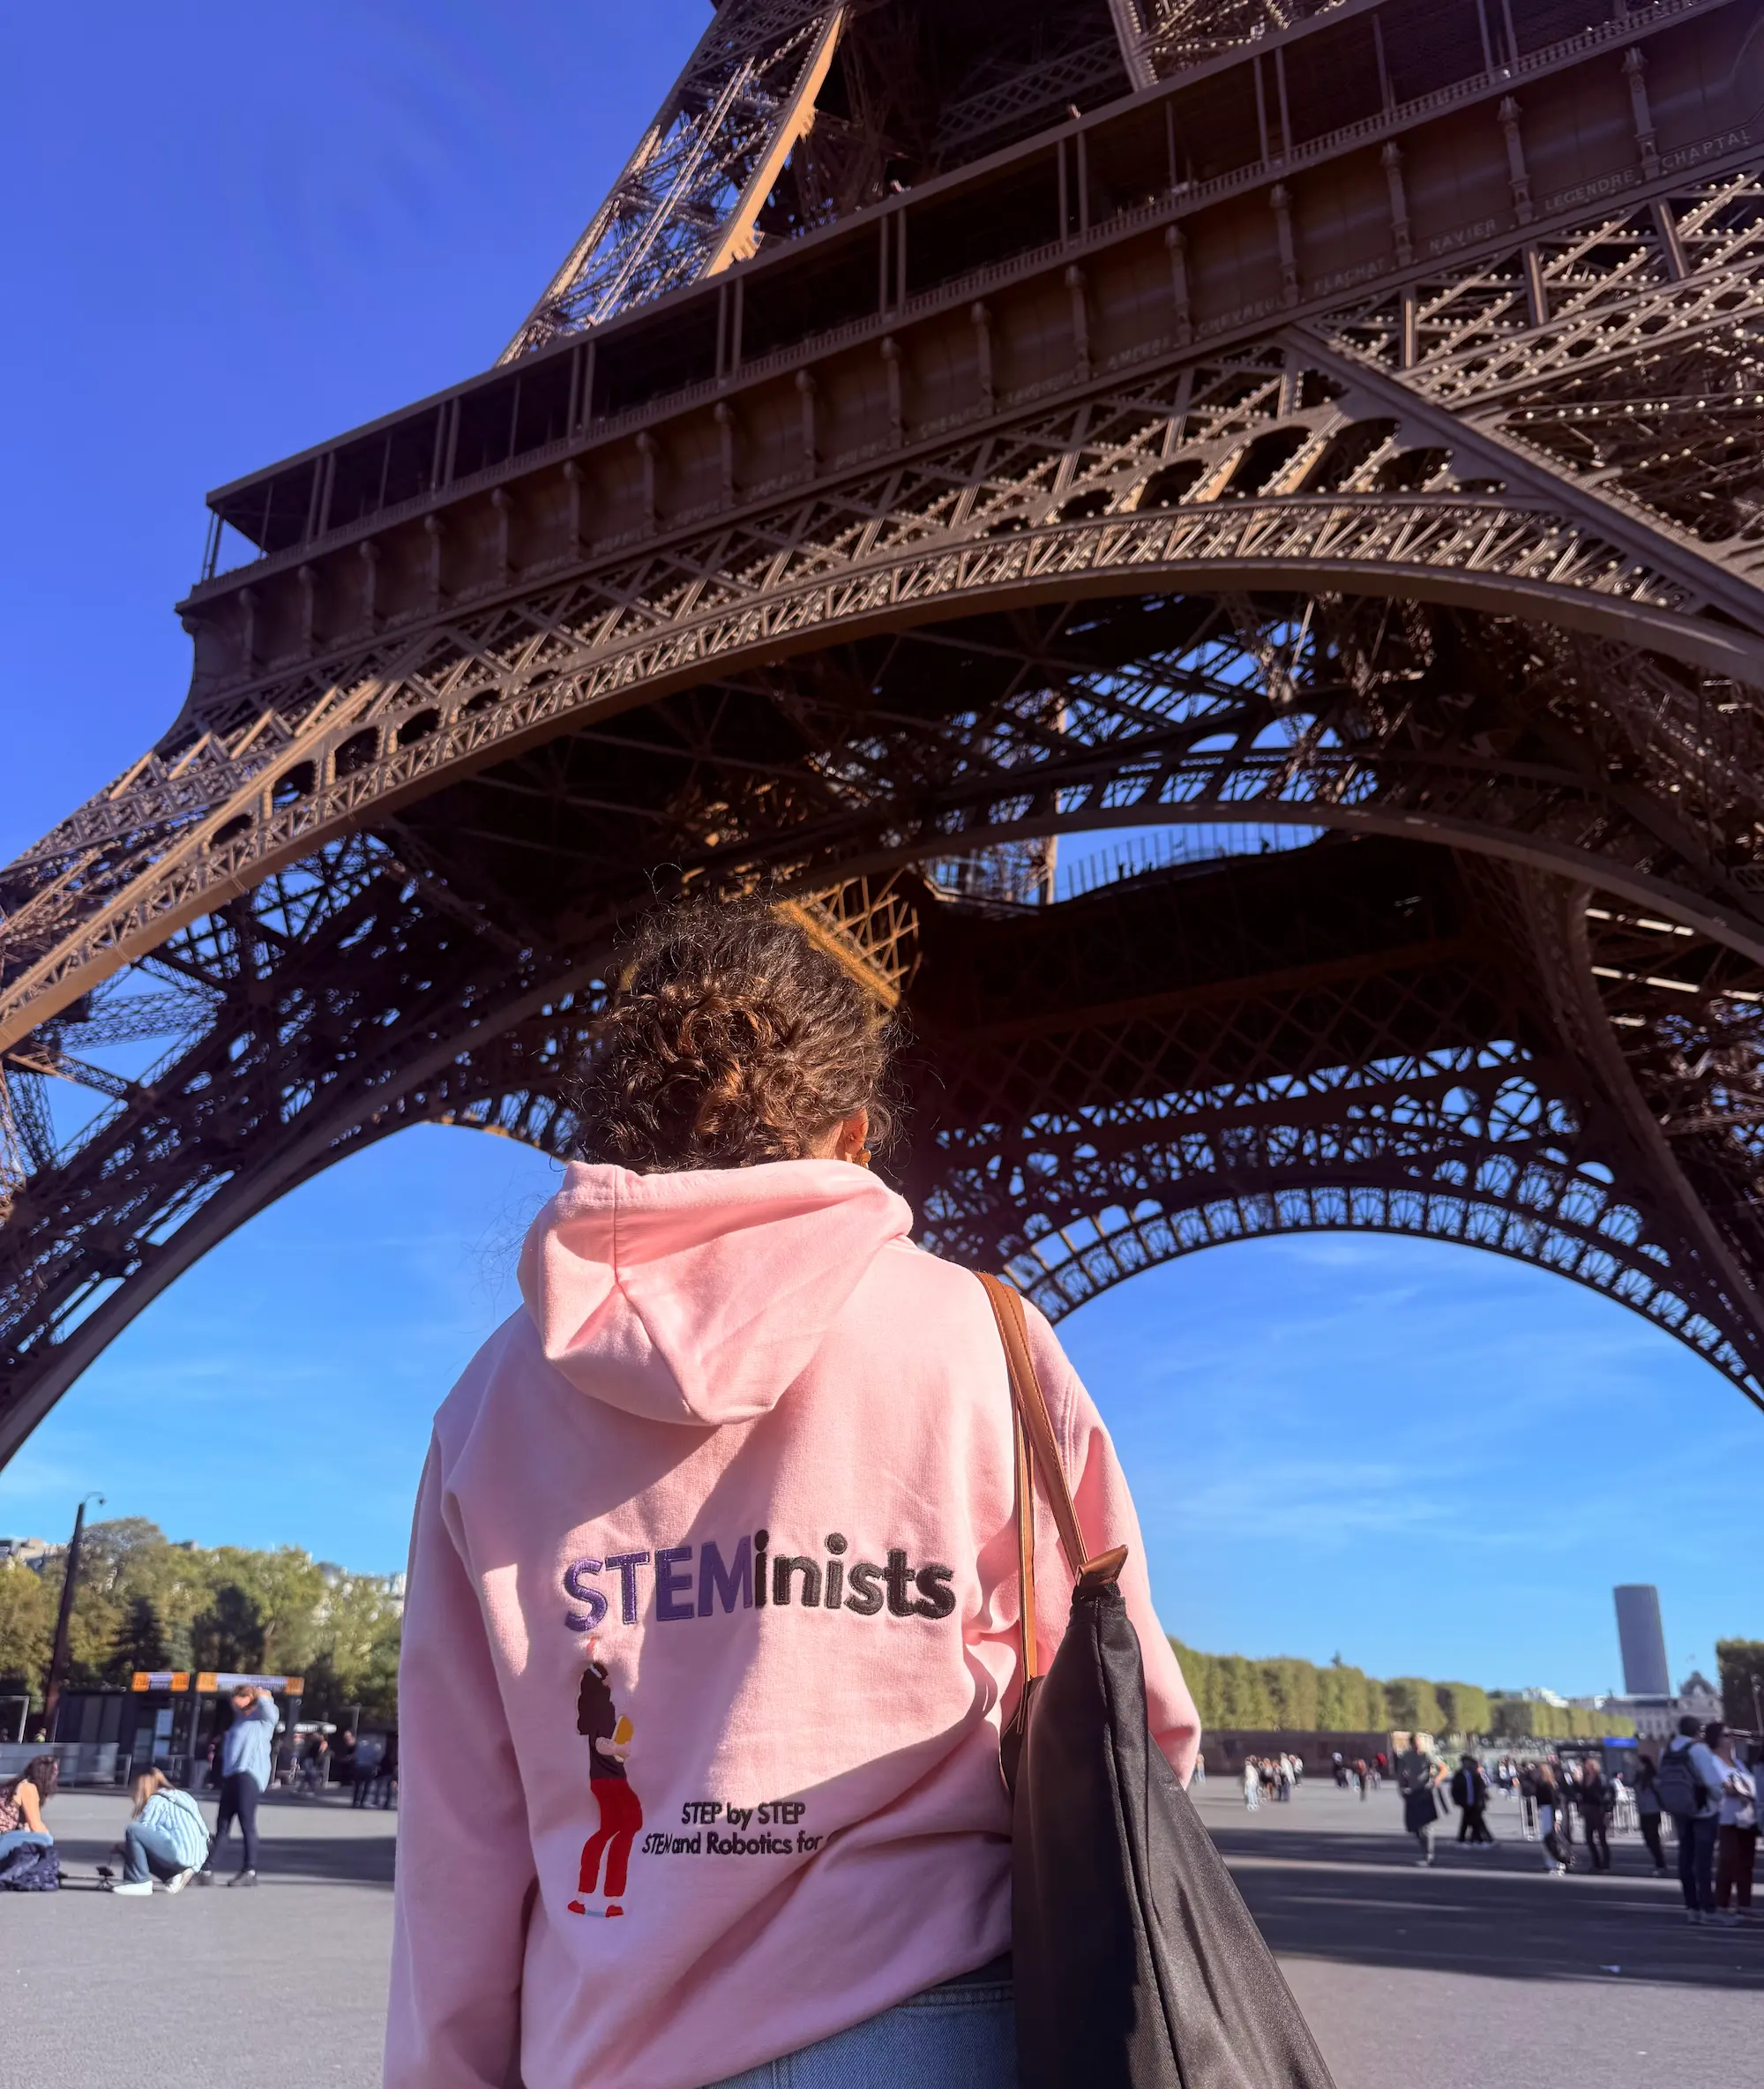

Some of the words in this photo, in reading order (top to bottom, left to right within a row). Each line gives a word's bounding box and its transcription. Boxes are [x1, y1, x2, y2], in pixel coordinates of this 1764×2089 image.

[1662, 129, 1751, 168] CHAPTAL
[1545, 169, 1635, 211] LEGENDRE
[1429, 219, 1497, 252] NAVIER
[564, 1529, 957, 1632] STEMinists
[681, 1802, 722, 1824] STEP
[726, 1802, 754, 1831] by
[758, 1802, 806, 1824] STEP
[672, 1831, 701, 1853] and
[706, 1831, 793, 1854] Robotics
[796, 1830, 823, 1852] for
